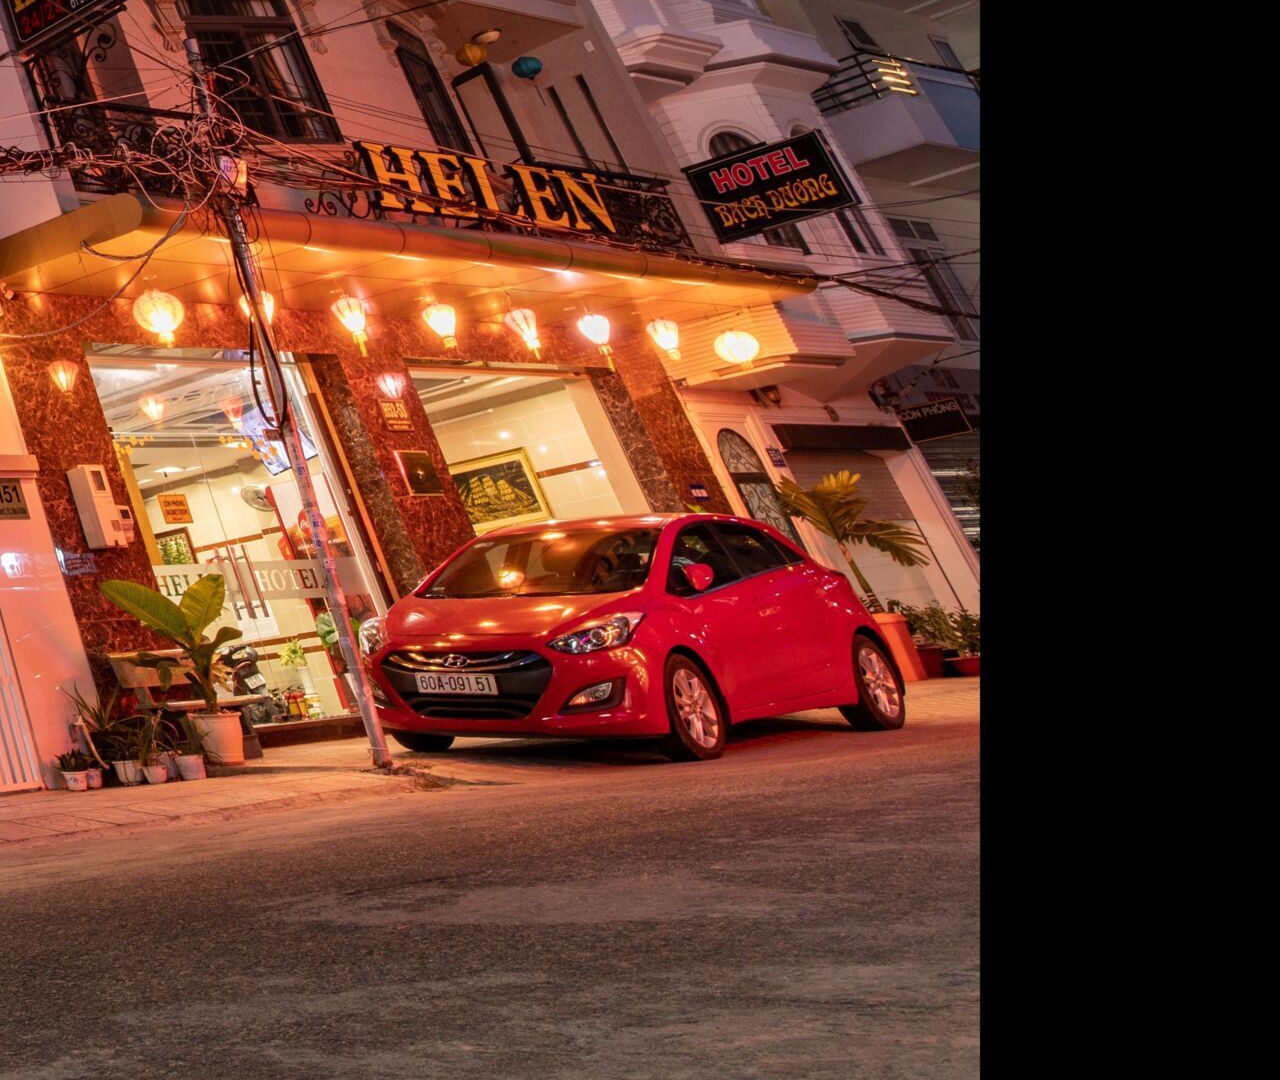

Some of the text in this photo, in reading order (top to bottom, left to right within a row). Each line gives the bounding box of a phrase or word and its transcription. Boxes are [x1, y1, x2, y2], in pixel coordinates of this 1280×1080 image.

[354, 140, 617, 234] HELEN
[709, 146, 811, 195] HOTEL
[255, 568, 326, 593] HOTEL
[420, 675, 493, 693] 60A-091.51
